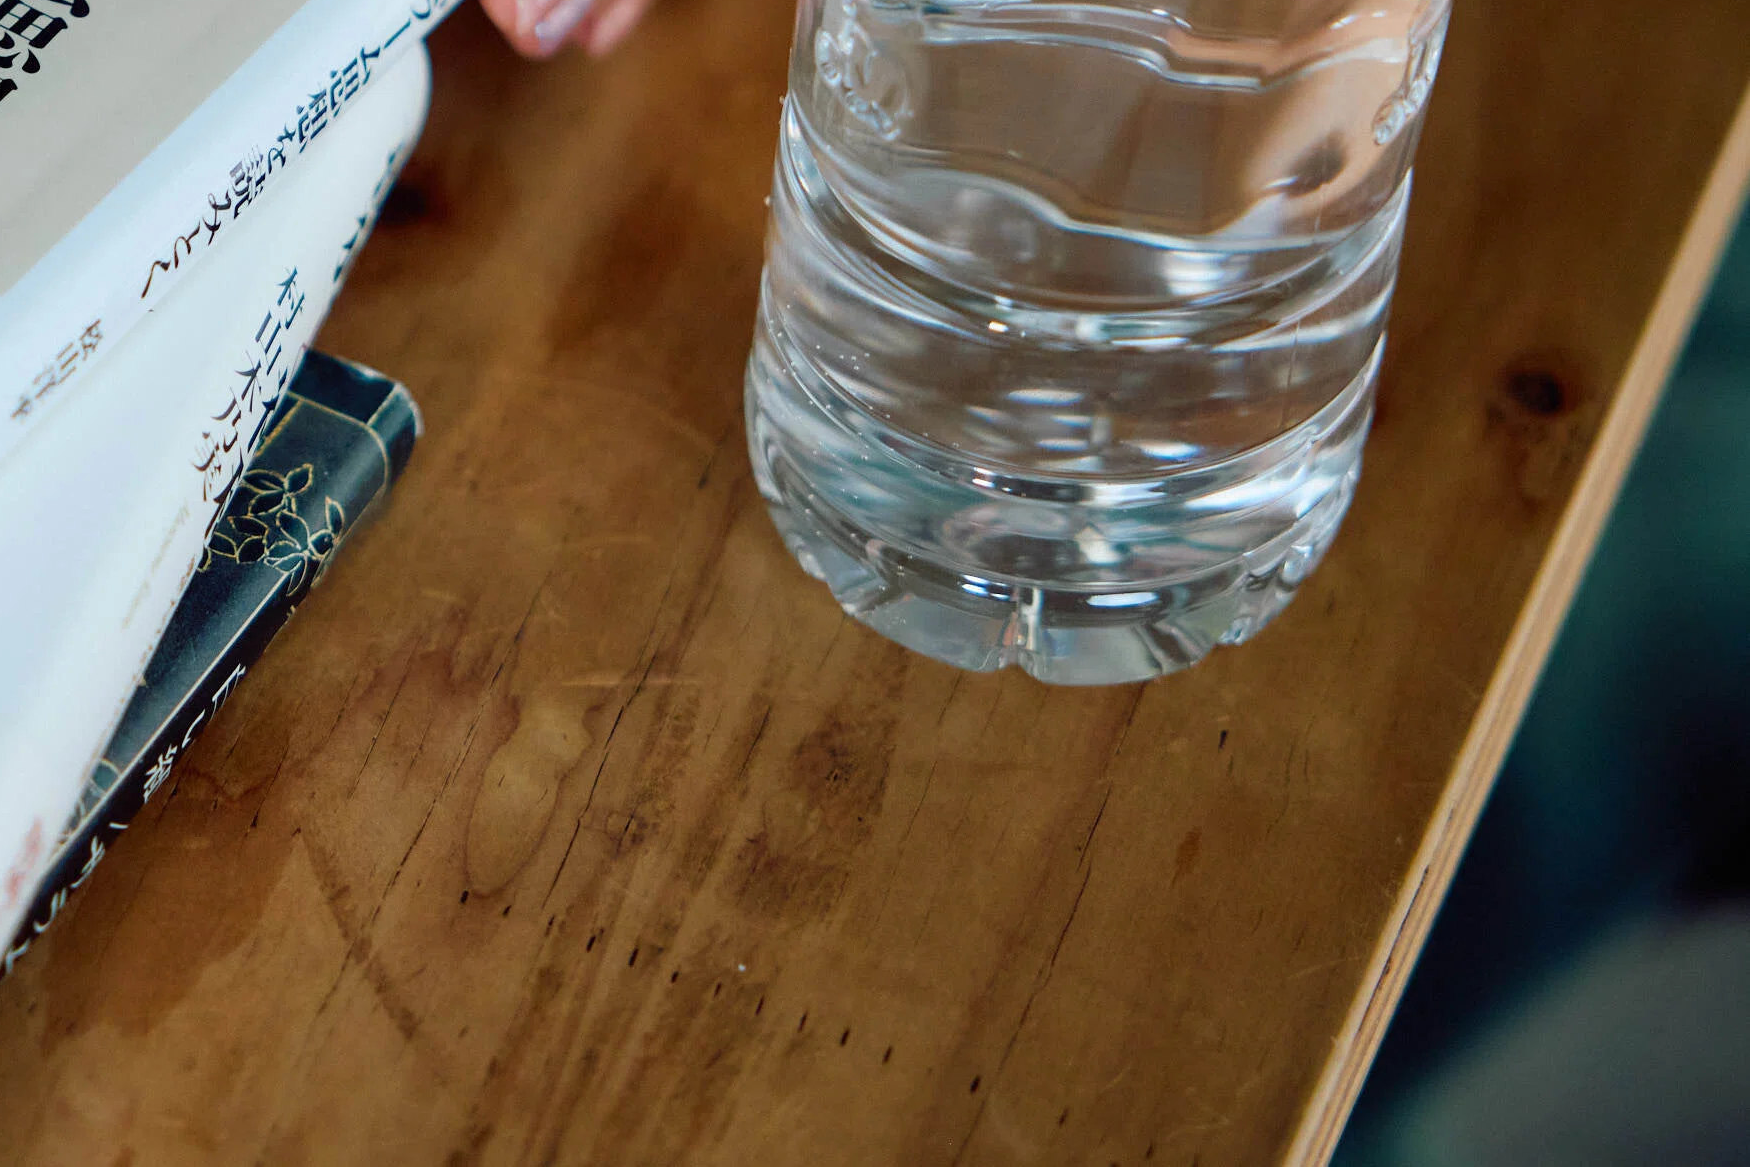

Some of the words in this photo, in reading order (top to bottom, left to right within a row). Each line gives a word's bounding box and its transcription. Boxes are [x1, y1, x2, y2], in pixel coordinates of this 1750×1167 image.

[189, 265, 306, 503] 村山木乃実
